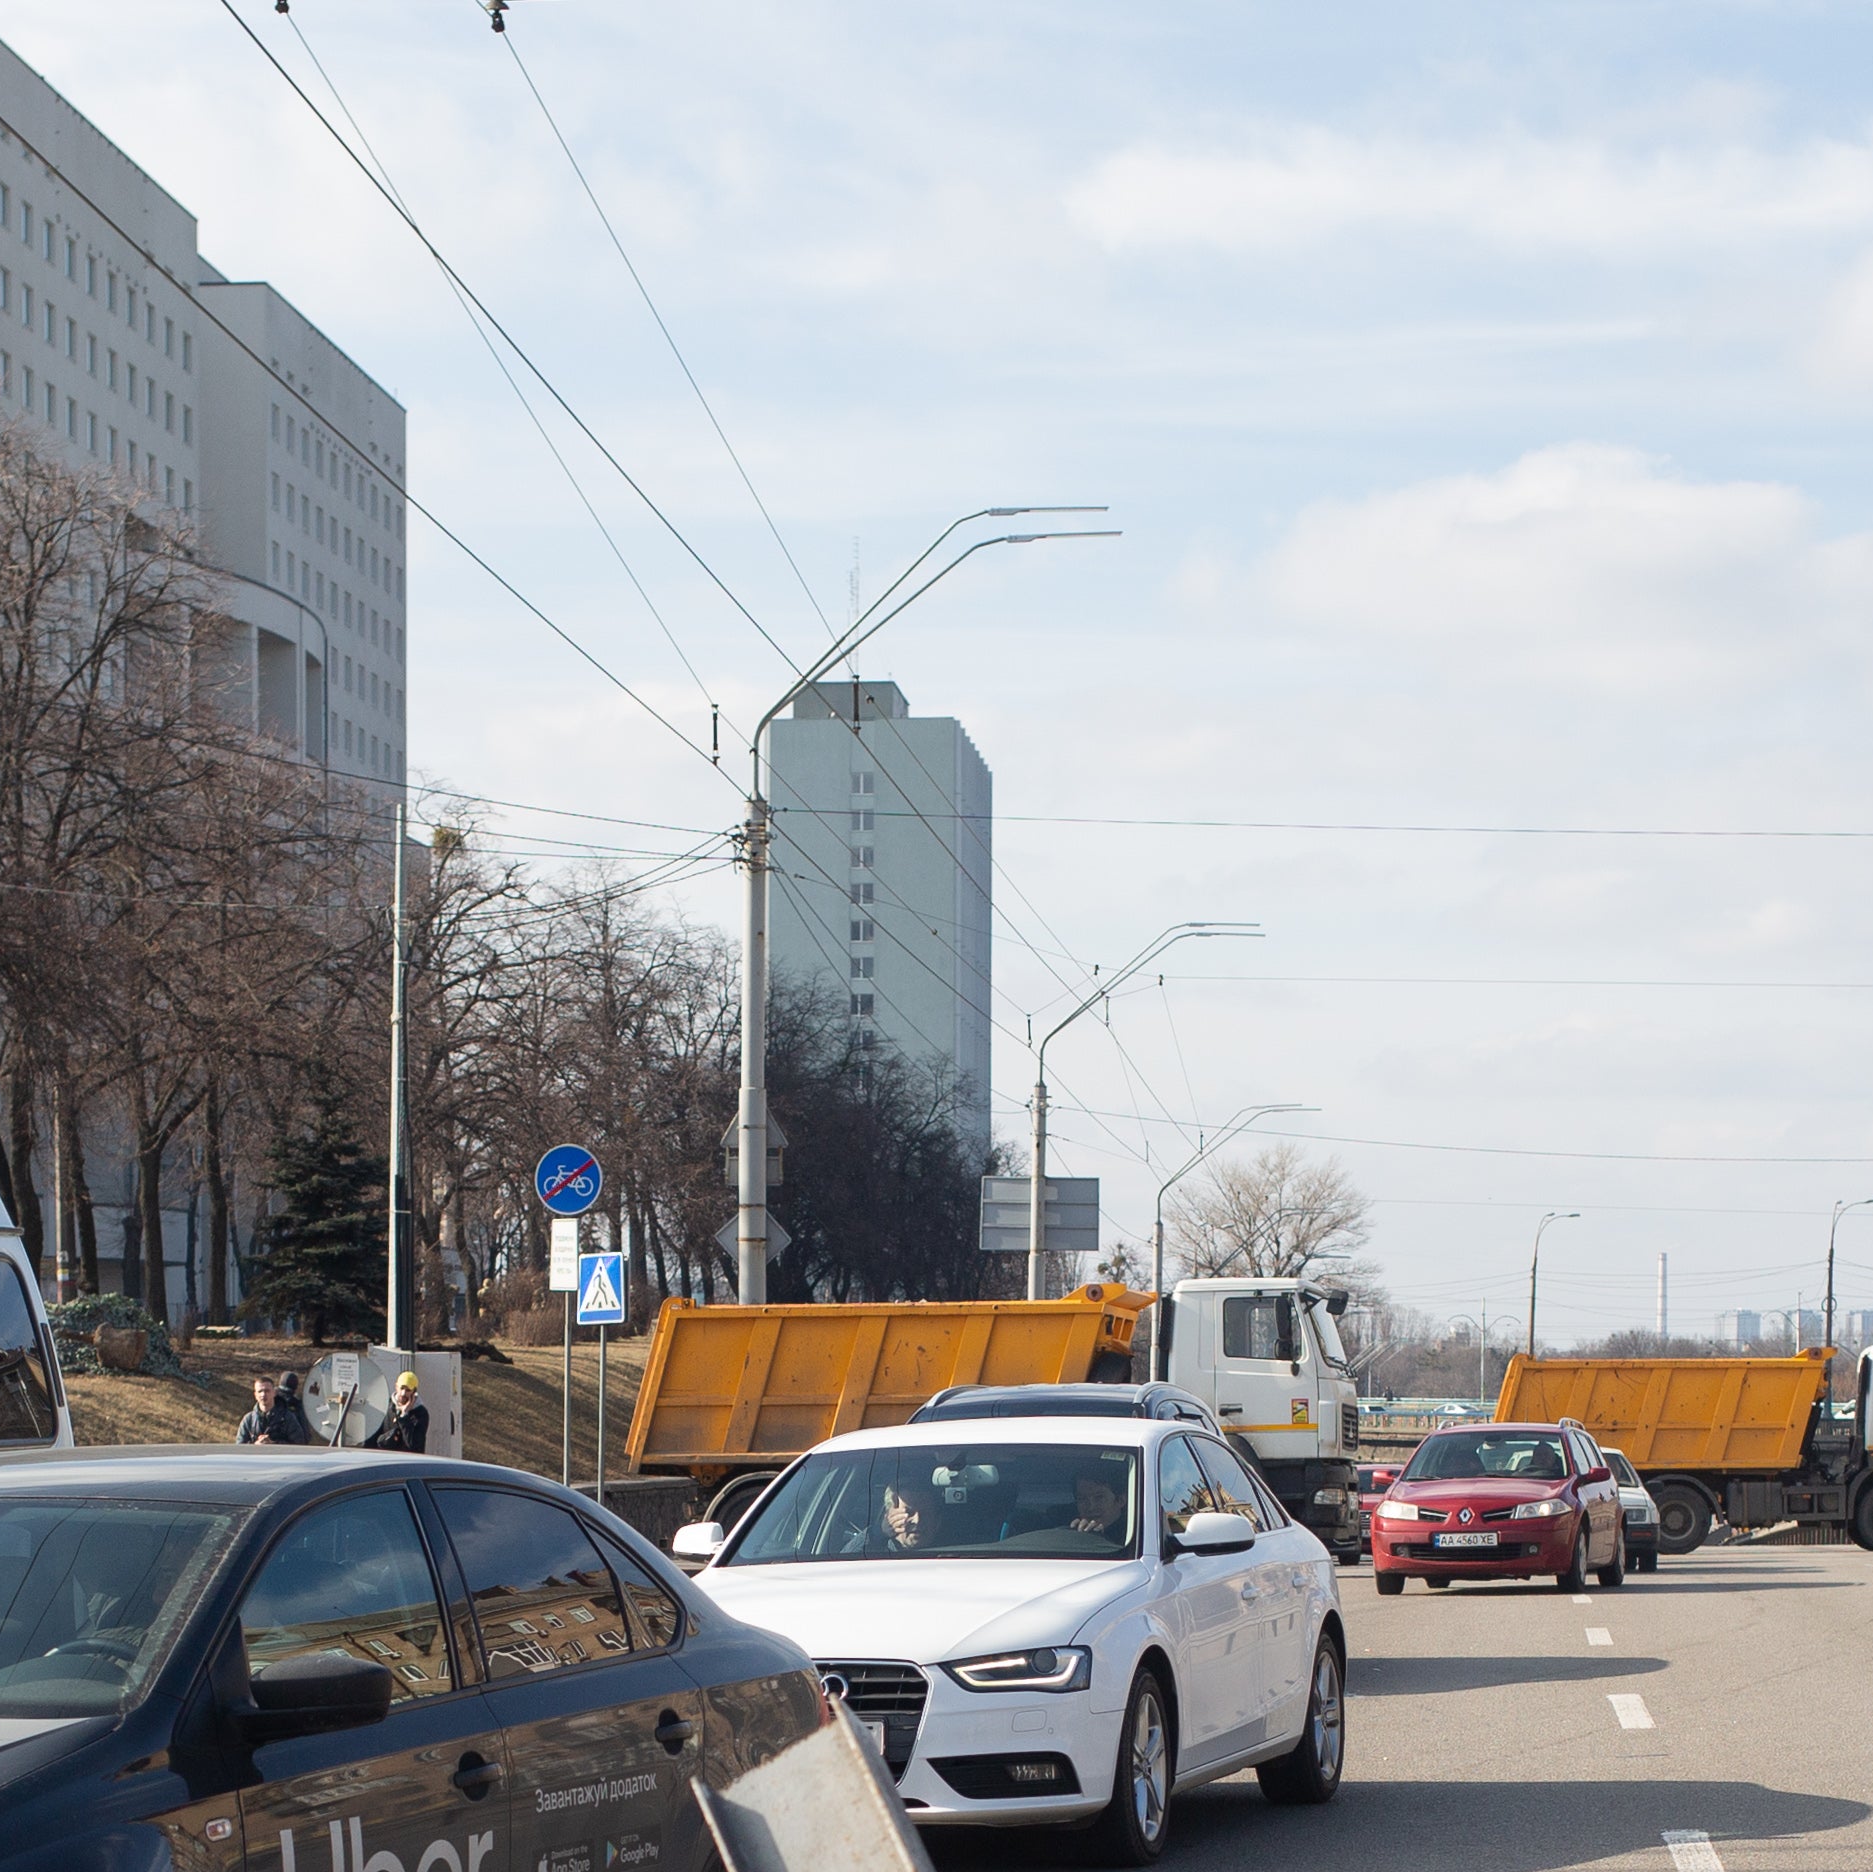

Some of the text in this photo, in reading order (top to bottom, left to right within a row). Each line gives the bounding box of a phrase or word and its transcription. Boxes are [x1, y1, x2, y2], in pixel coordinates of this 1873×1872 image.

[1456, 1535, 1478, 1545] 4560
[535, 1773, 657, 1813] Завантажуй додаток
[620, 1842, 659, 1864] Google Play
